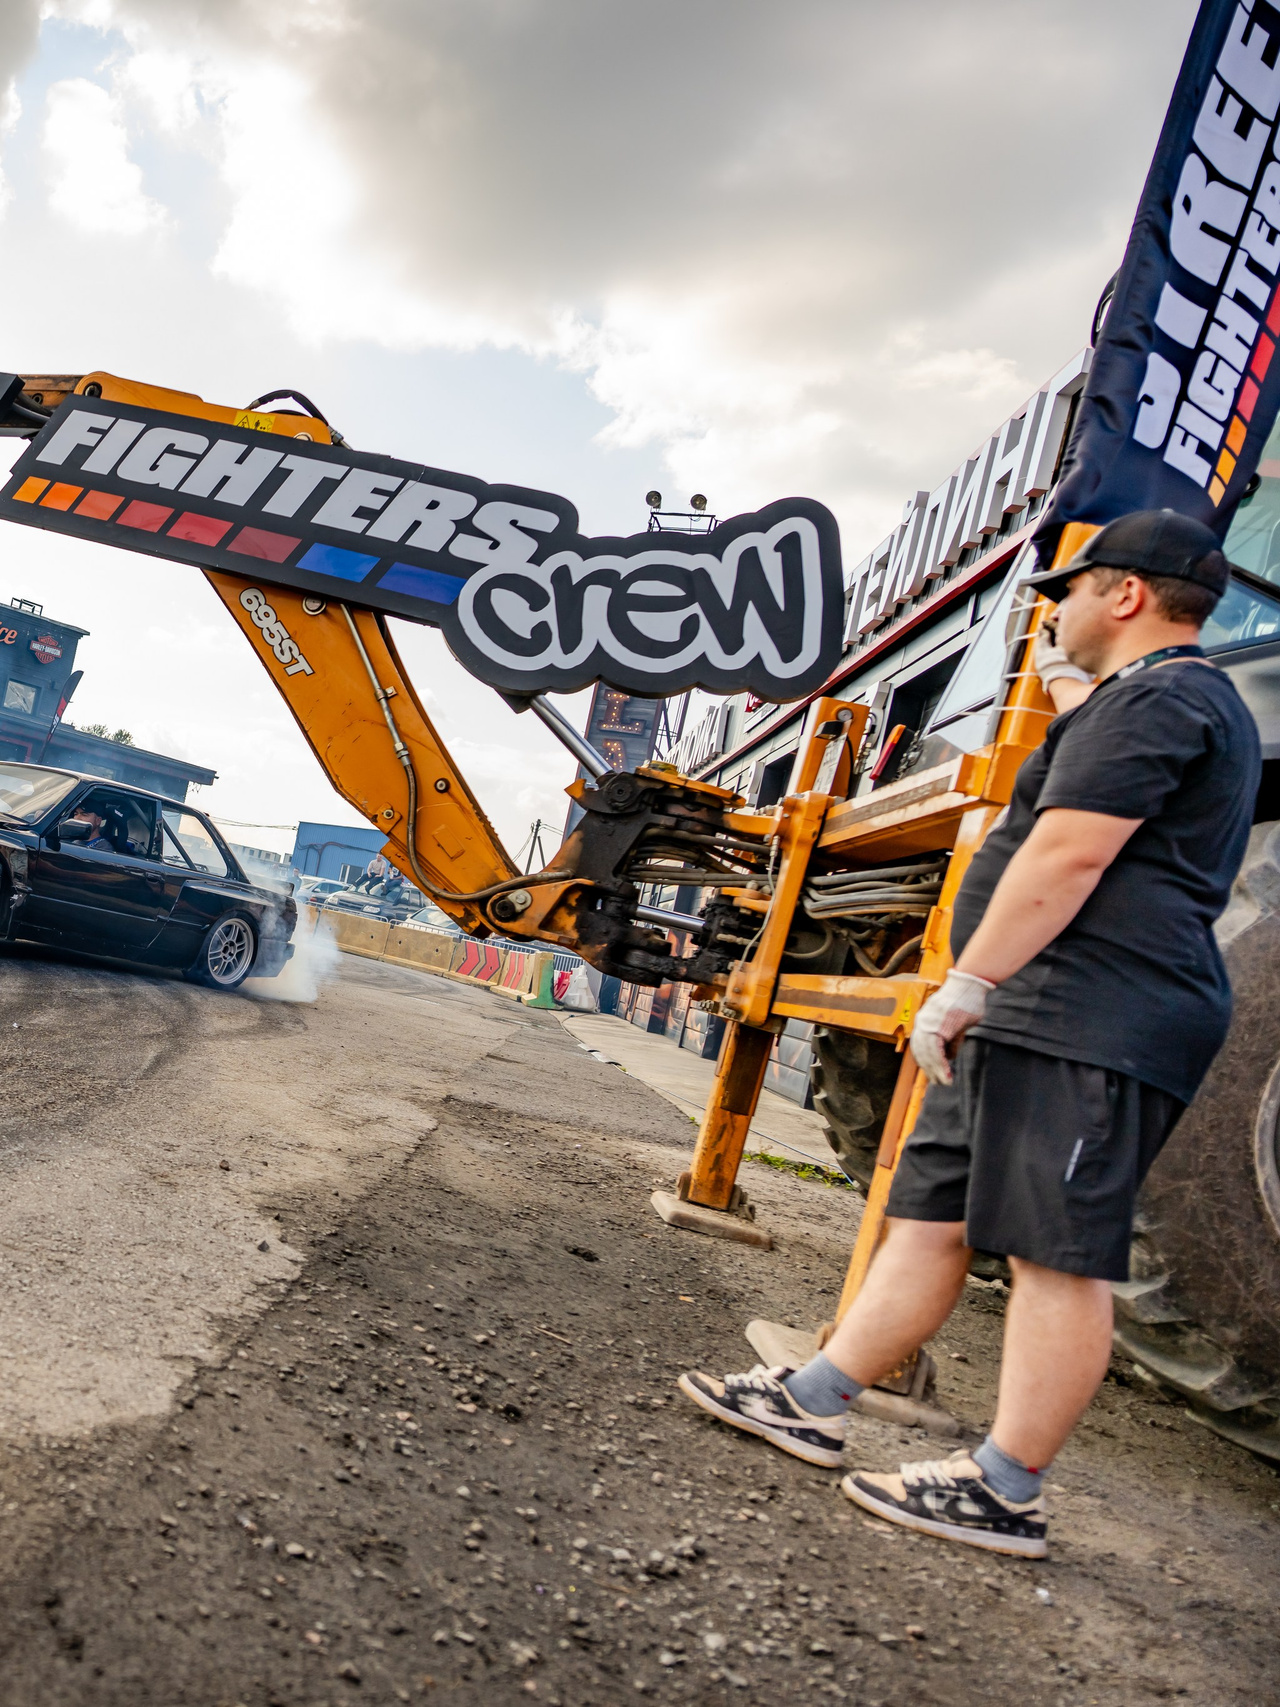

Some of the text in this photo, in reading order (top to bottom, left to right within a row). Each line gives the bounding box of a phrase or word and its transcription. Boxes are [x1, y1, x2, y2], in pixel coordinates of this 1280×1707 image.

[1163, 115, 1280, 488] FIGHTER
[35, 409, 559, 565] FIGHTERS
[842, 347, 1095, 646] ТЕЙЛИНГ
[239, 587, 315, 677] 695ST
[460, 517, 823, 679] crew
